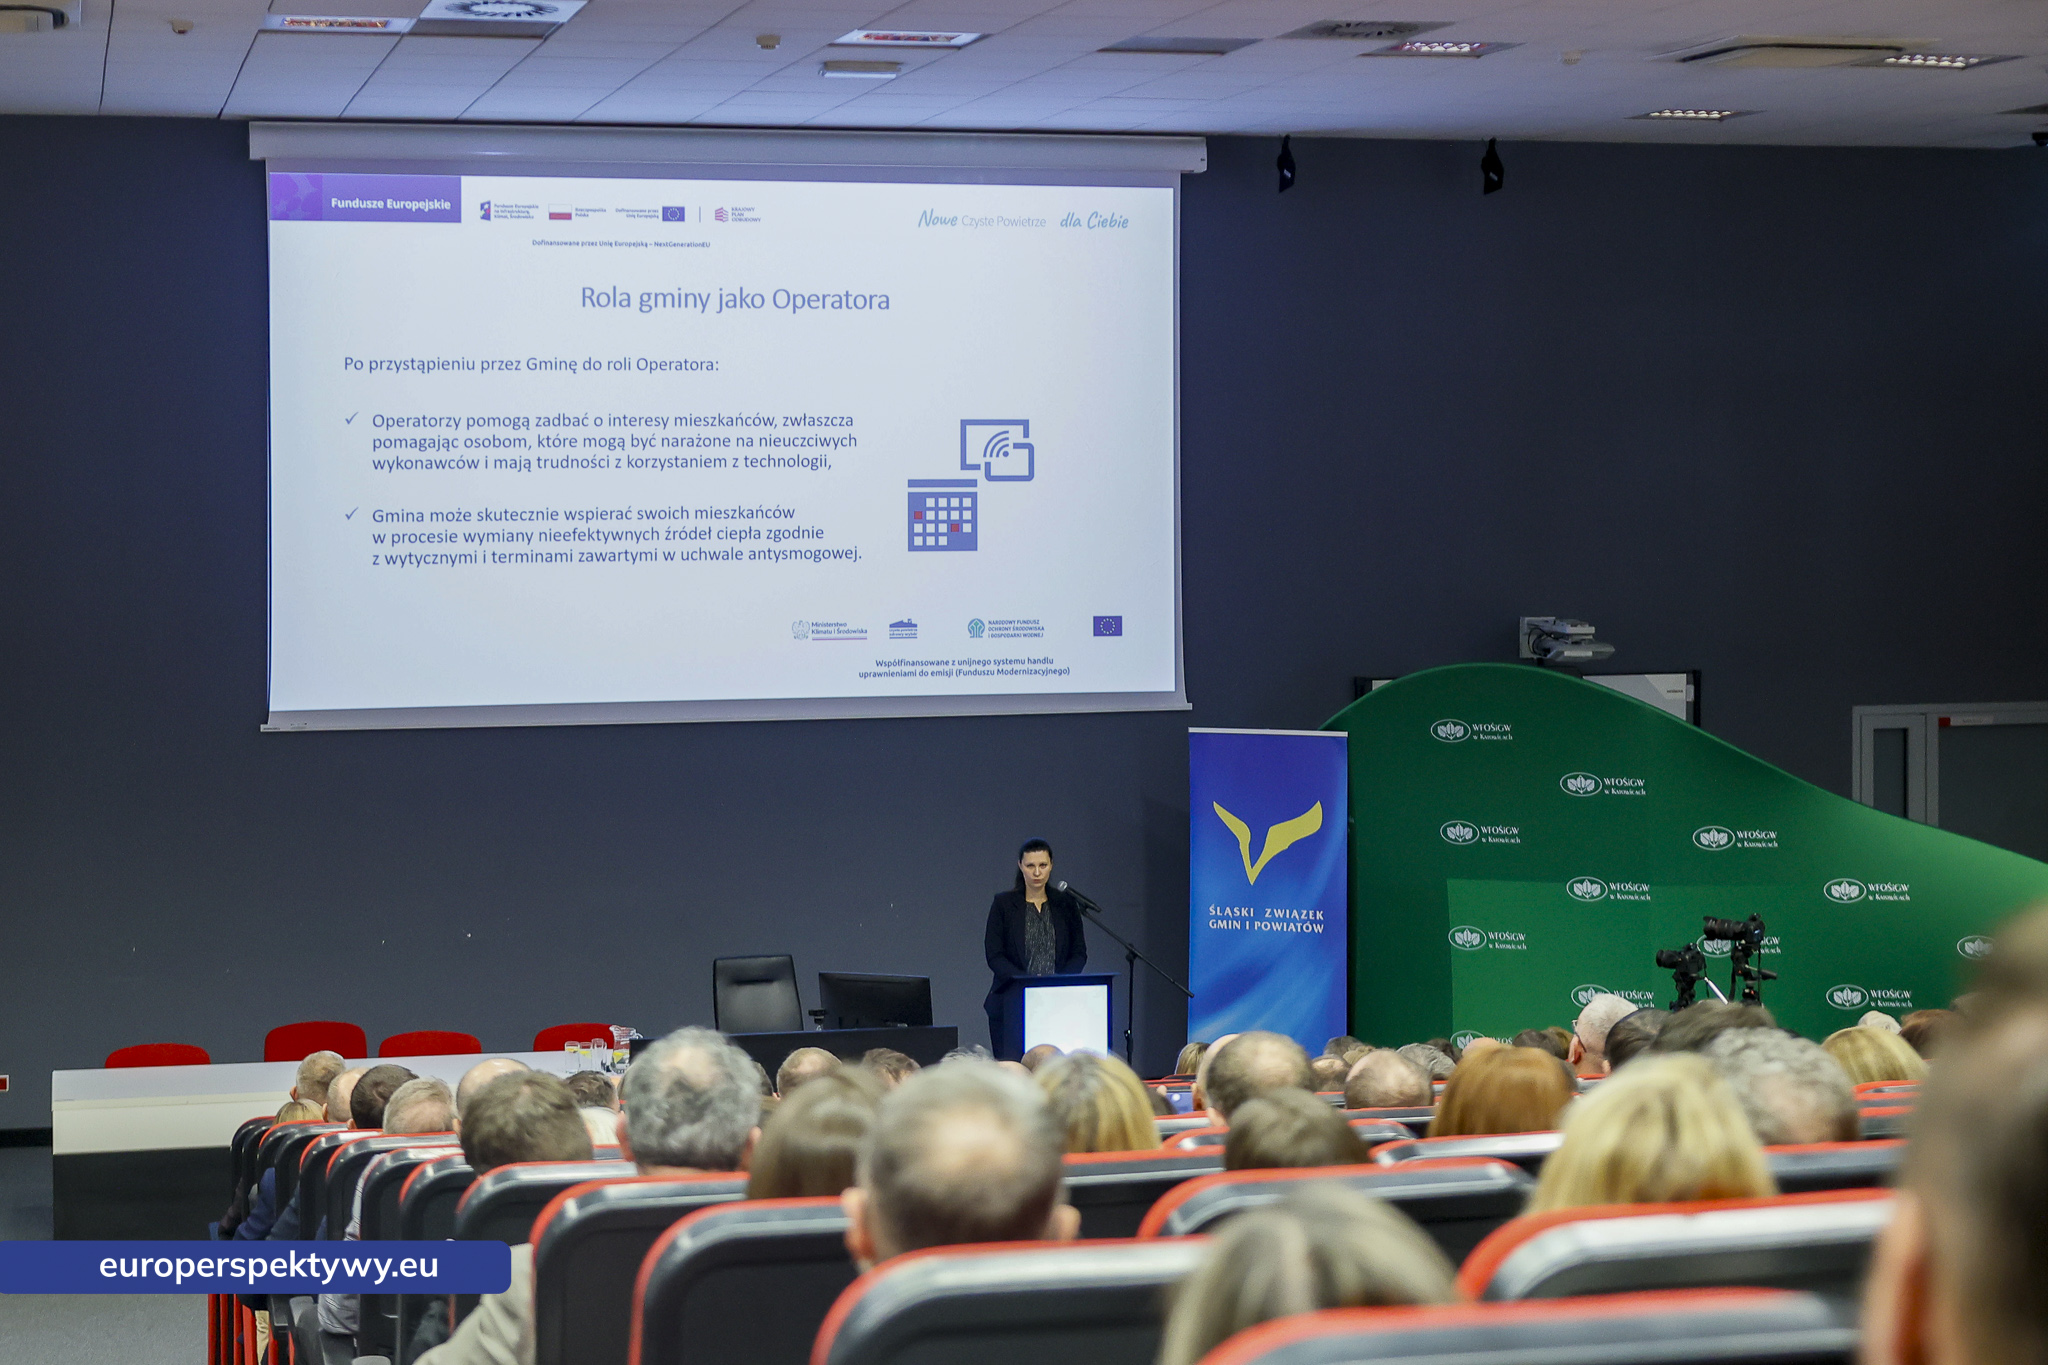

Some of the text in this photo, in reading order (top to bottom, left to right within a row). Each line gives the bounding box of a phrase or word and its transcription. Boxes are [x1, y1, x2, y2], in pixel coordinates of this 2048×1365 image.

[332, 198, 451, 212] Fundusze Europejskie
[918, 208, 1129, 229] Nowe Czyste Powietrze dla Ciebie
[598, 240, 614, 248] Unię
[582, 285, 889, 314] Rola gminy jako Operatora
[345, 357, 718, 374] Po przystąpieniu przez Gminę do roli Operatora:
[373, 412, 853, 431] Operatorzy pomogą zadbać o interesy mieszkańców, zwłaszcza
[373, 433, 856, 452] pomagając osobom, które mogą być narażone na nieuczciwych
[372, 454, 831, 474] wykonawców i mają trudności z korzystaniem z technologii,
[373, 505, 795, 523] Gmina może skutecznie wspierać swoich mieszkańców
[372, 526, 823, 546] w procesie wymiany nieefektywnych źródeł ciepła zgodnie
[373, 546, 861, 567] z wytycznymi i terminami zawartymi w uchwale antysmogowej.
[876, 659, 949, 668] Współfinansowane
[958, 658, 991, 667] unijnego
[992, 658, 1026, 666] systemu
[1027, 657, 1054, 665] handlu
[859, 670, 916, 679] uprawnieniami
[931, 669, 953, 678] emisji
[955, 669, 995, 677] (Funduszu
[997, 667, 1070, 677] Modernizacyjnego)
[1209, 904, 1324, 921] ŚLĄSKI ZWIĄZEK
[1209, 919, 1324, 934] GMIN I POWIATÓW
